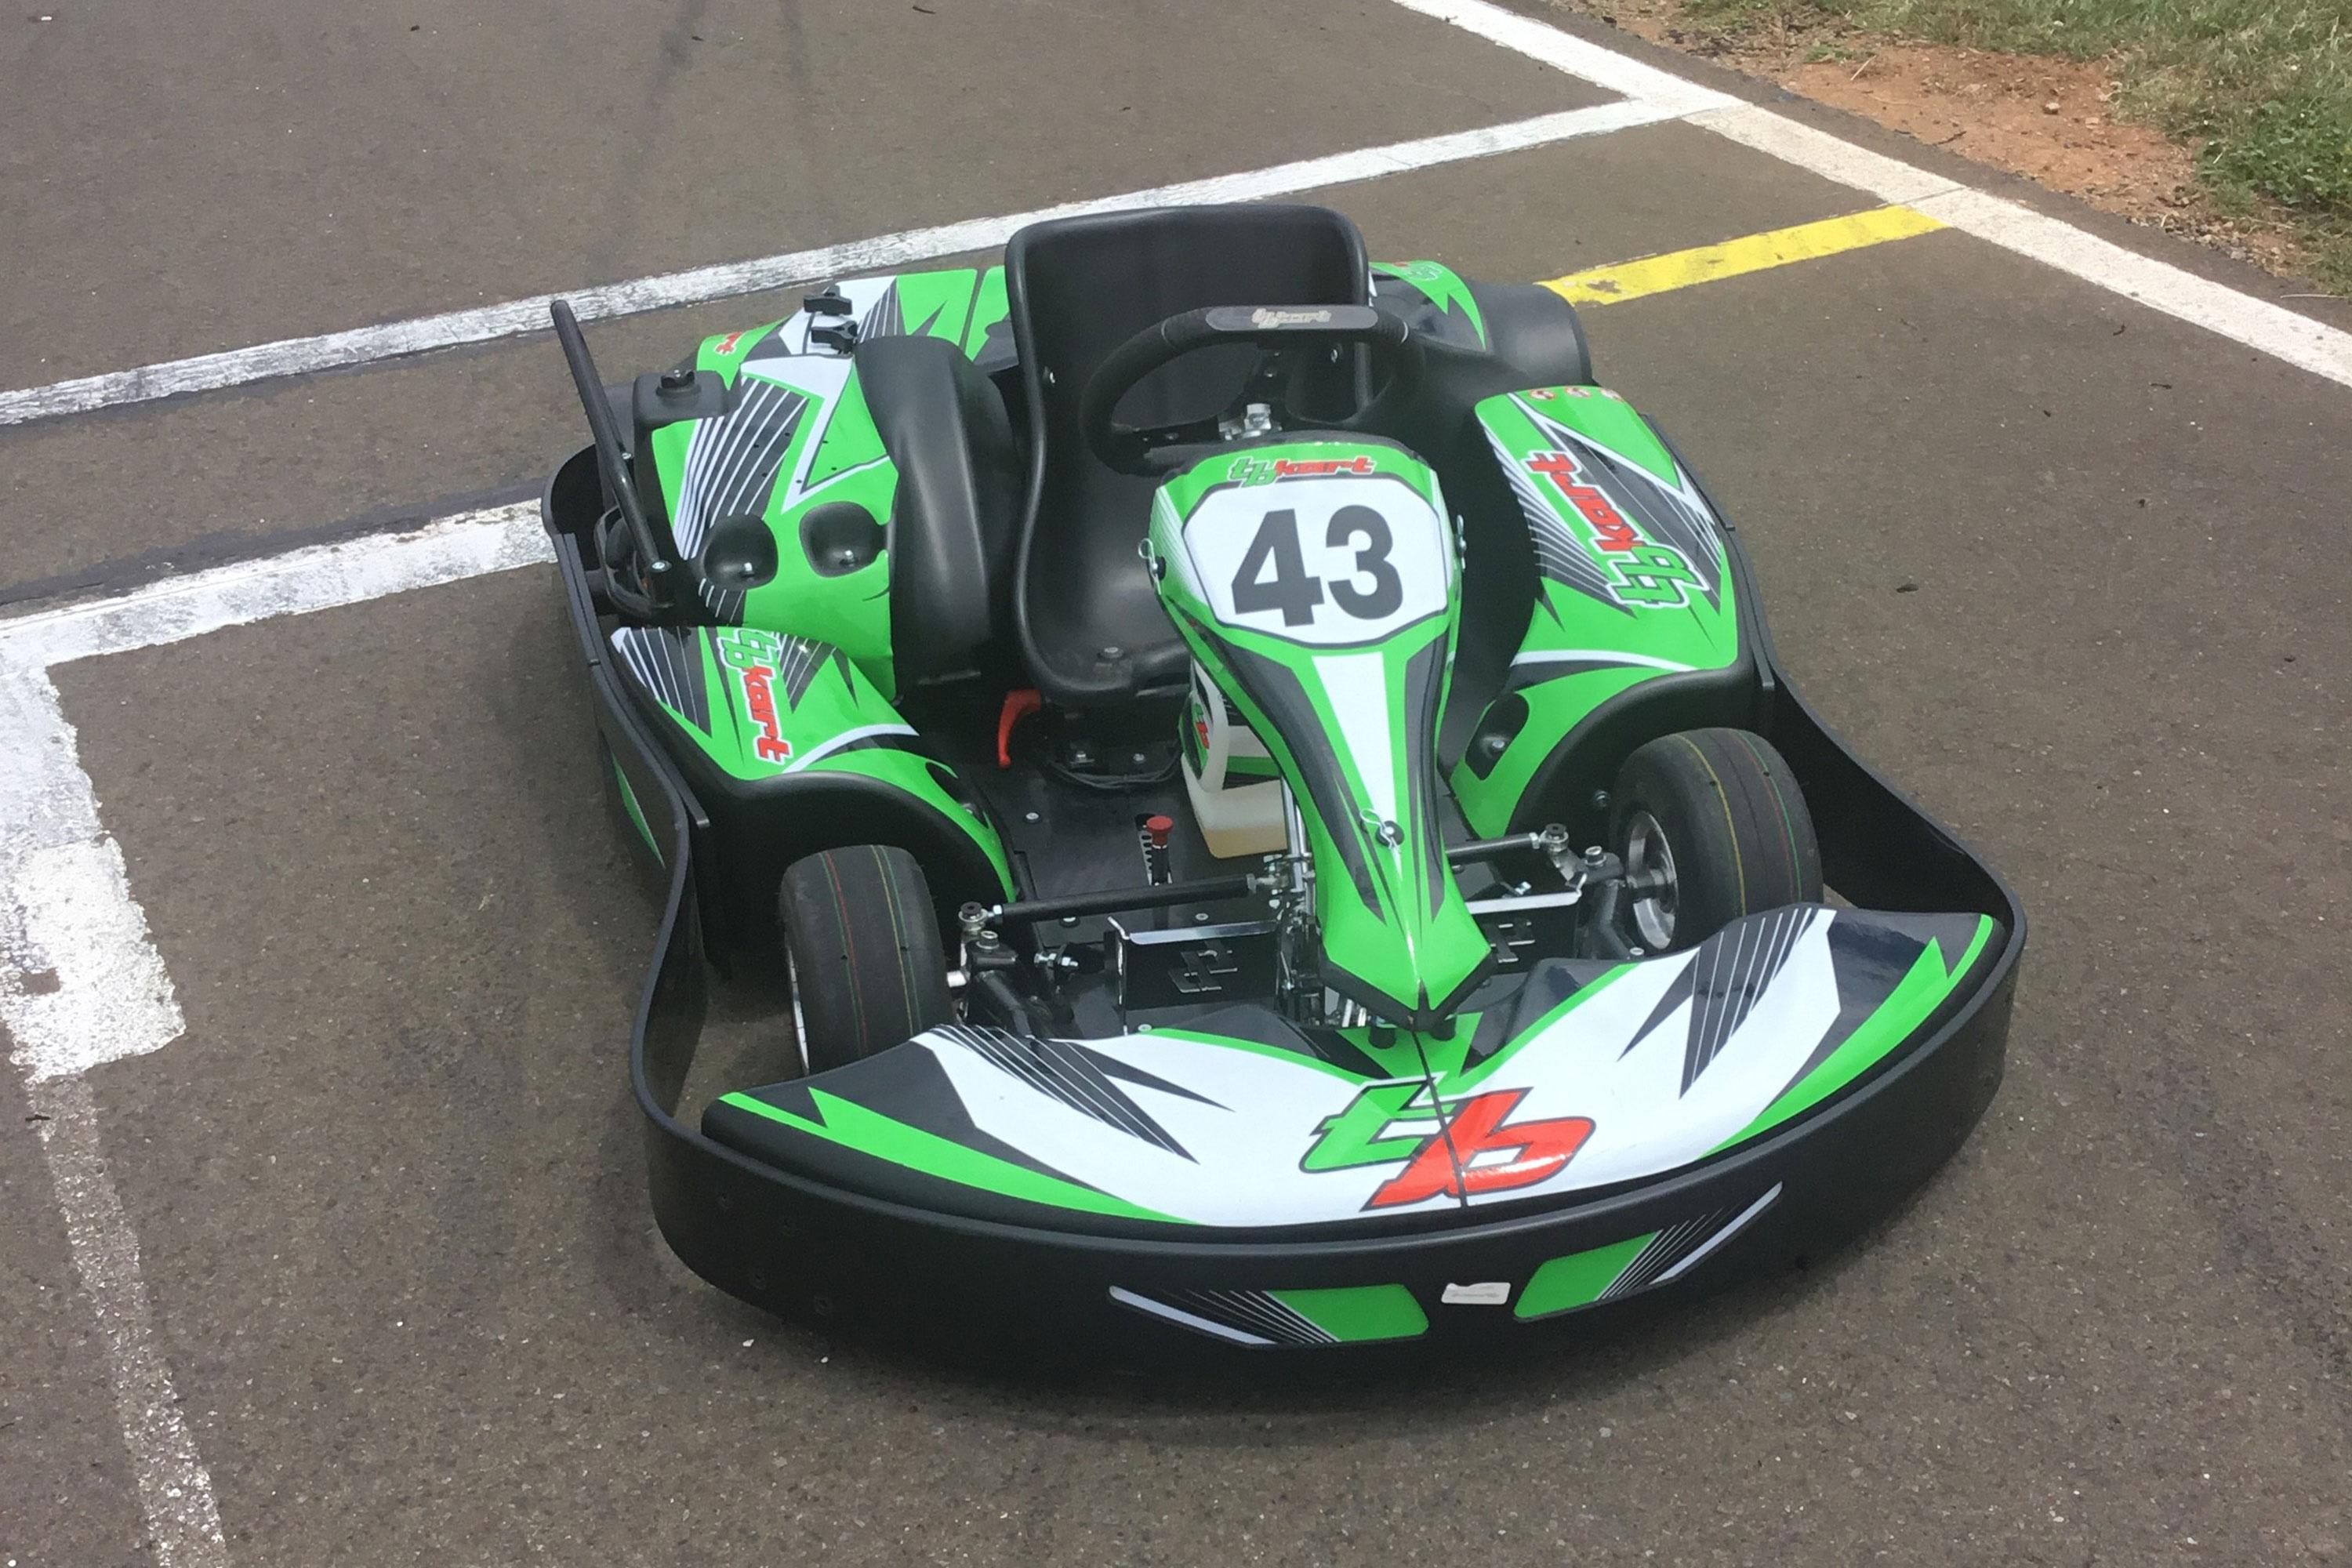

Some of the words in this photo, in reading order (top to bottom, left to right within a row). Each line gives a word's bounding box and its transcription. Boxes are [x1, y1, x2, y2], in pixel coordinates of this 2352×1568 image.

[1228, 456, 1377, 488] tbkart
[1523, 451, 1708, 606] tbkart
[1232, 505, 1403, 627] 43
